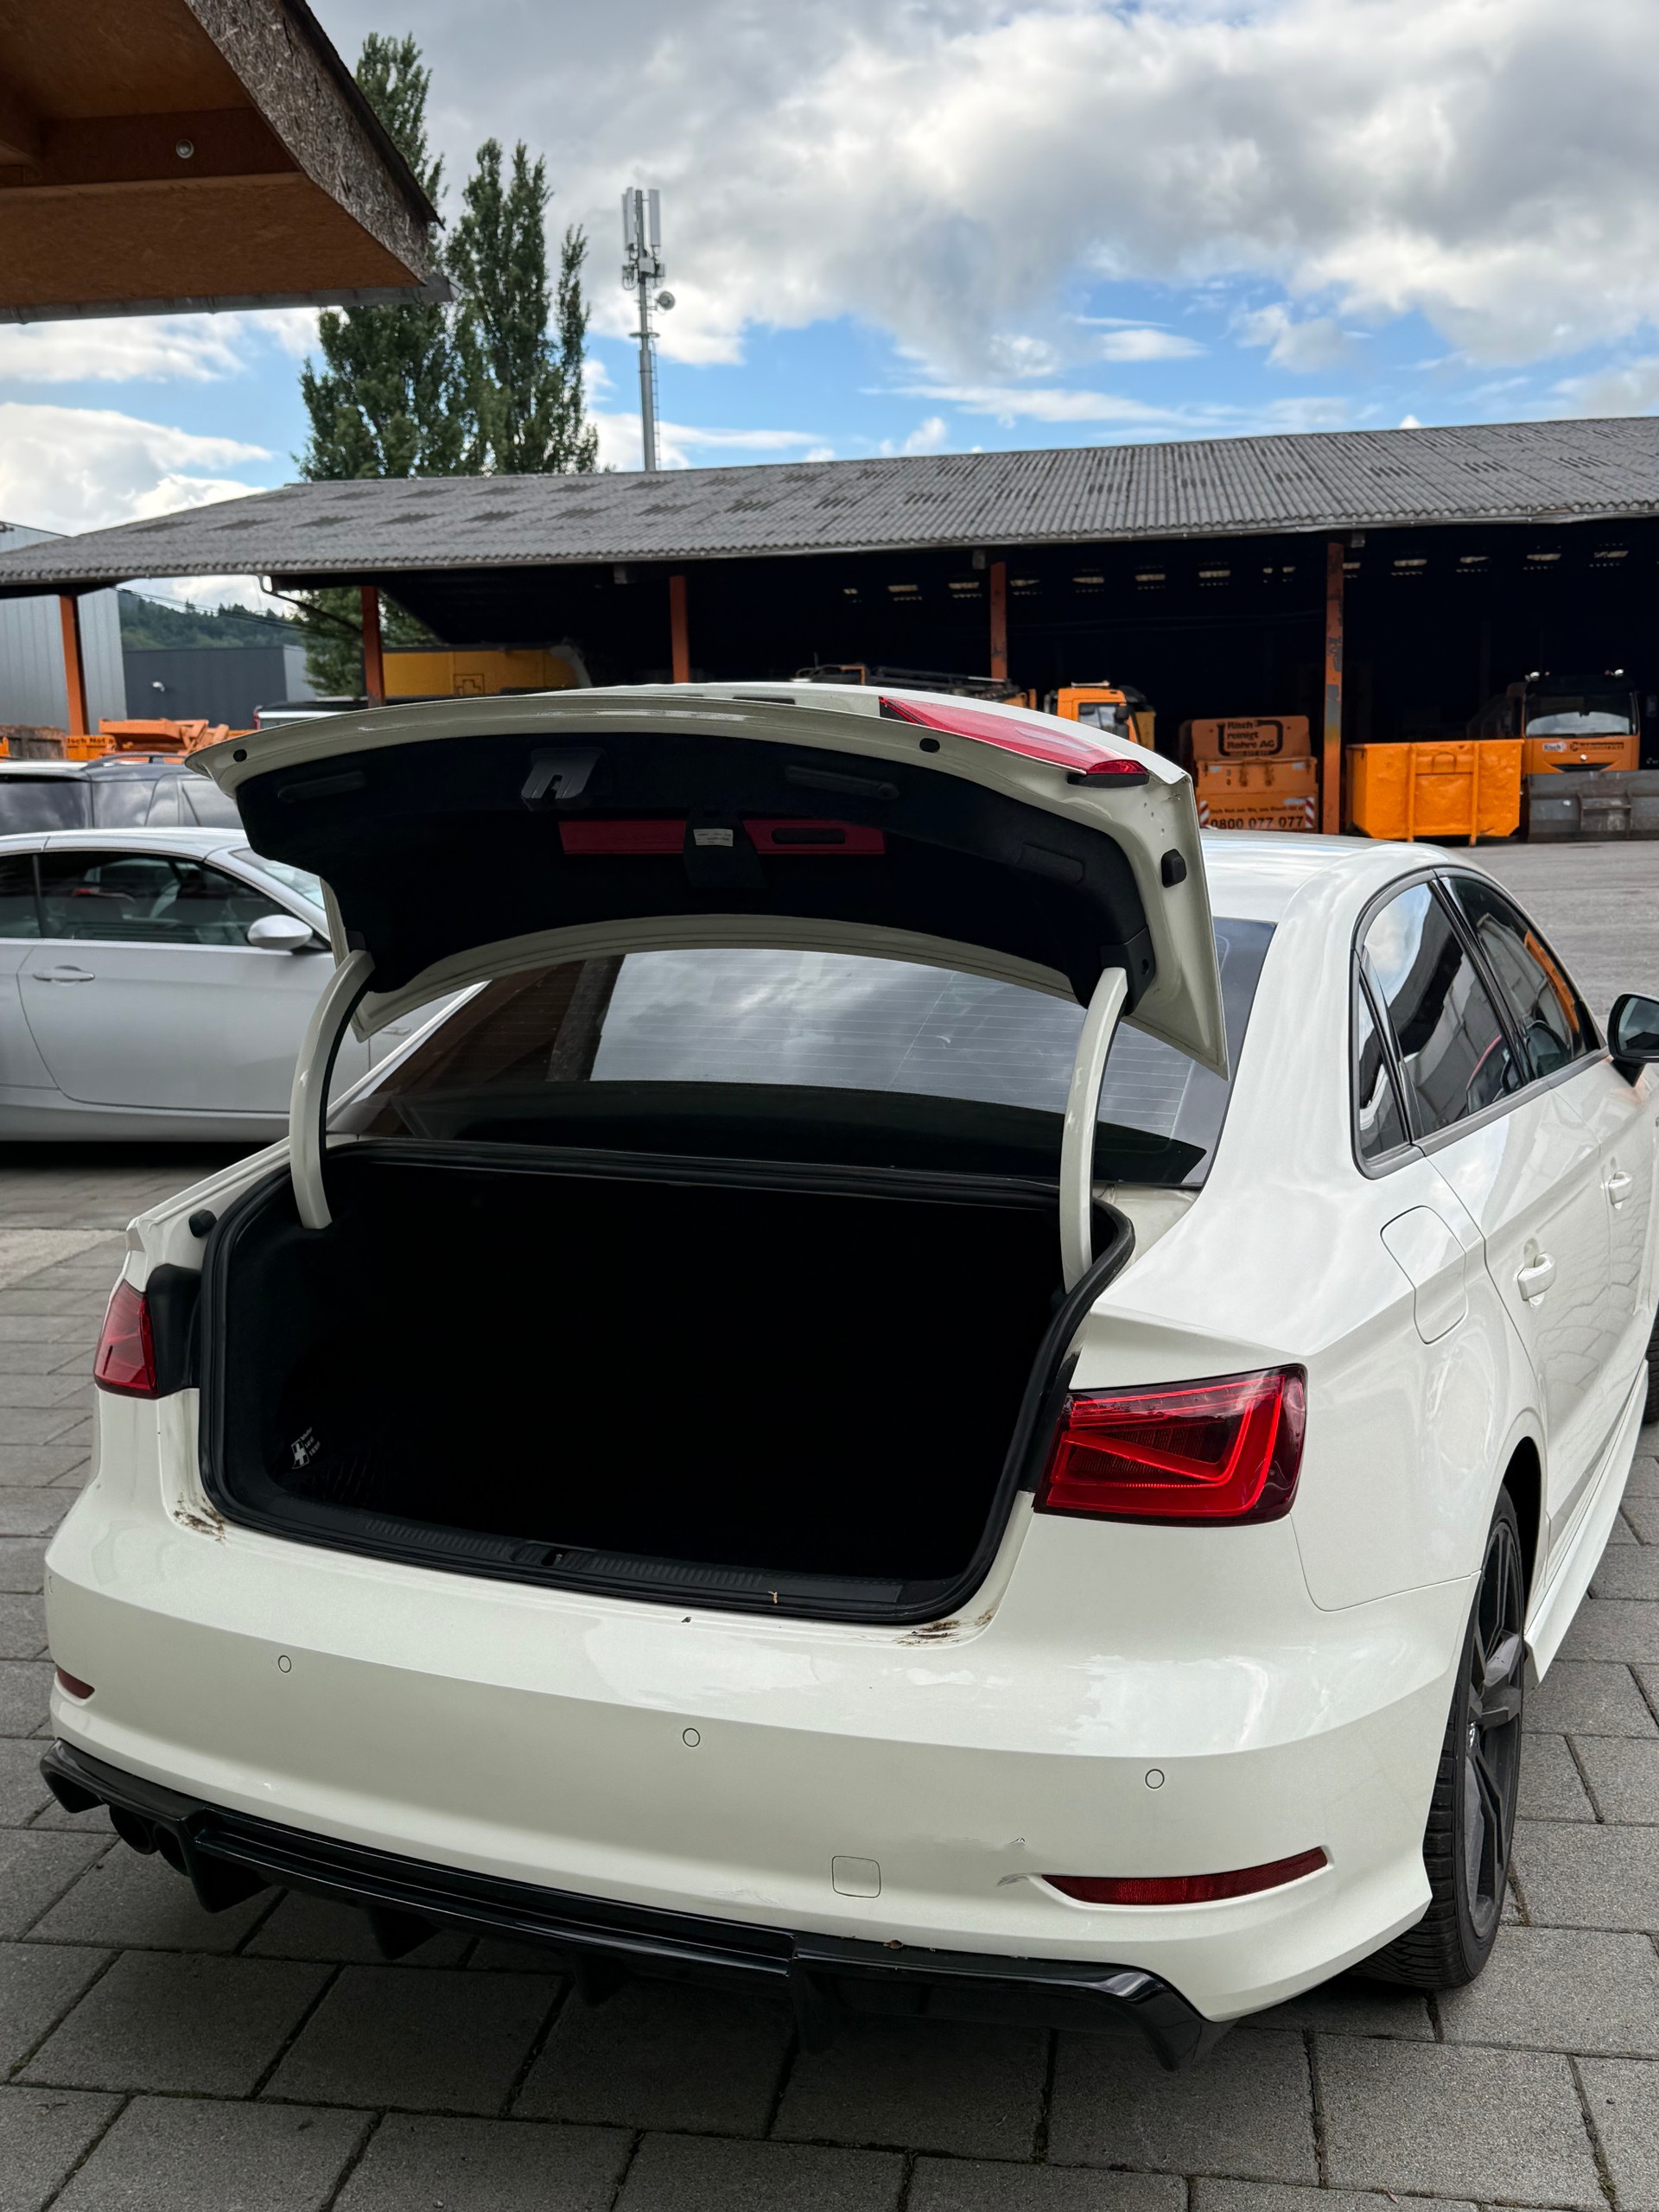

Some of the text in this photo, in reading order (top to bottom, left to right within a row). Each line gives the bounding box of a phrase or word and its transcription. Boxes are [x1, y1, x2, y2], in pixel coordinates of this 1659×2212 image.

[1211, 816, 1304, 830] 0800 077 077
